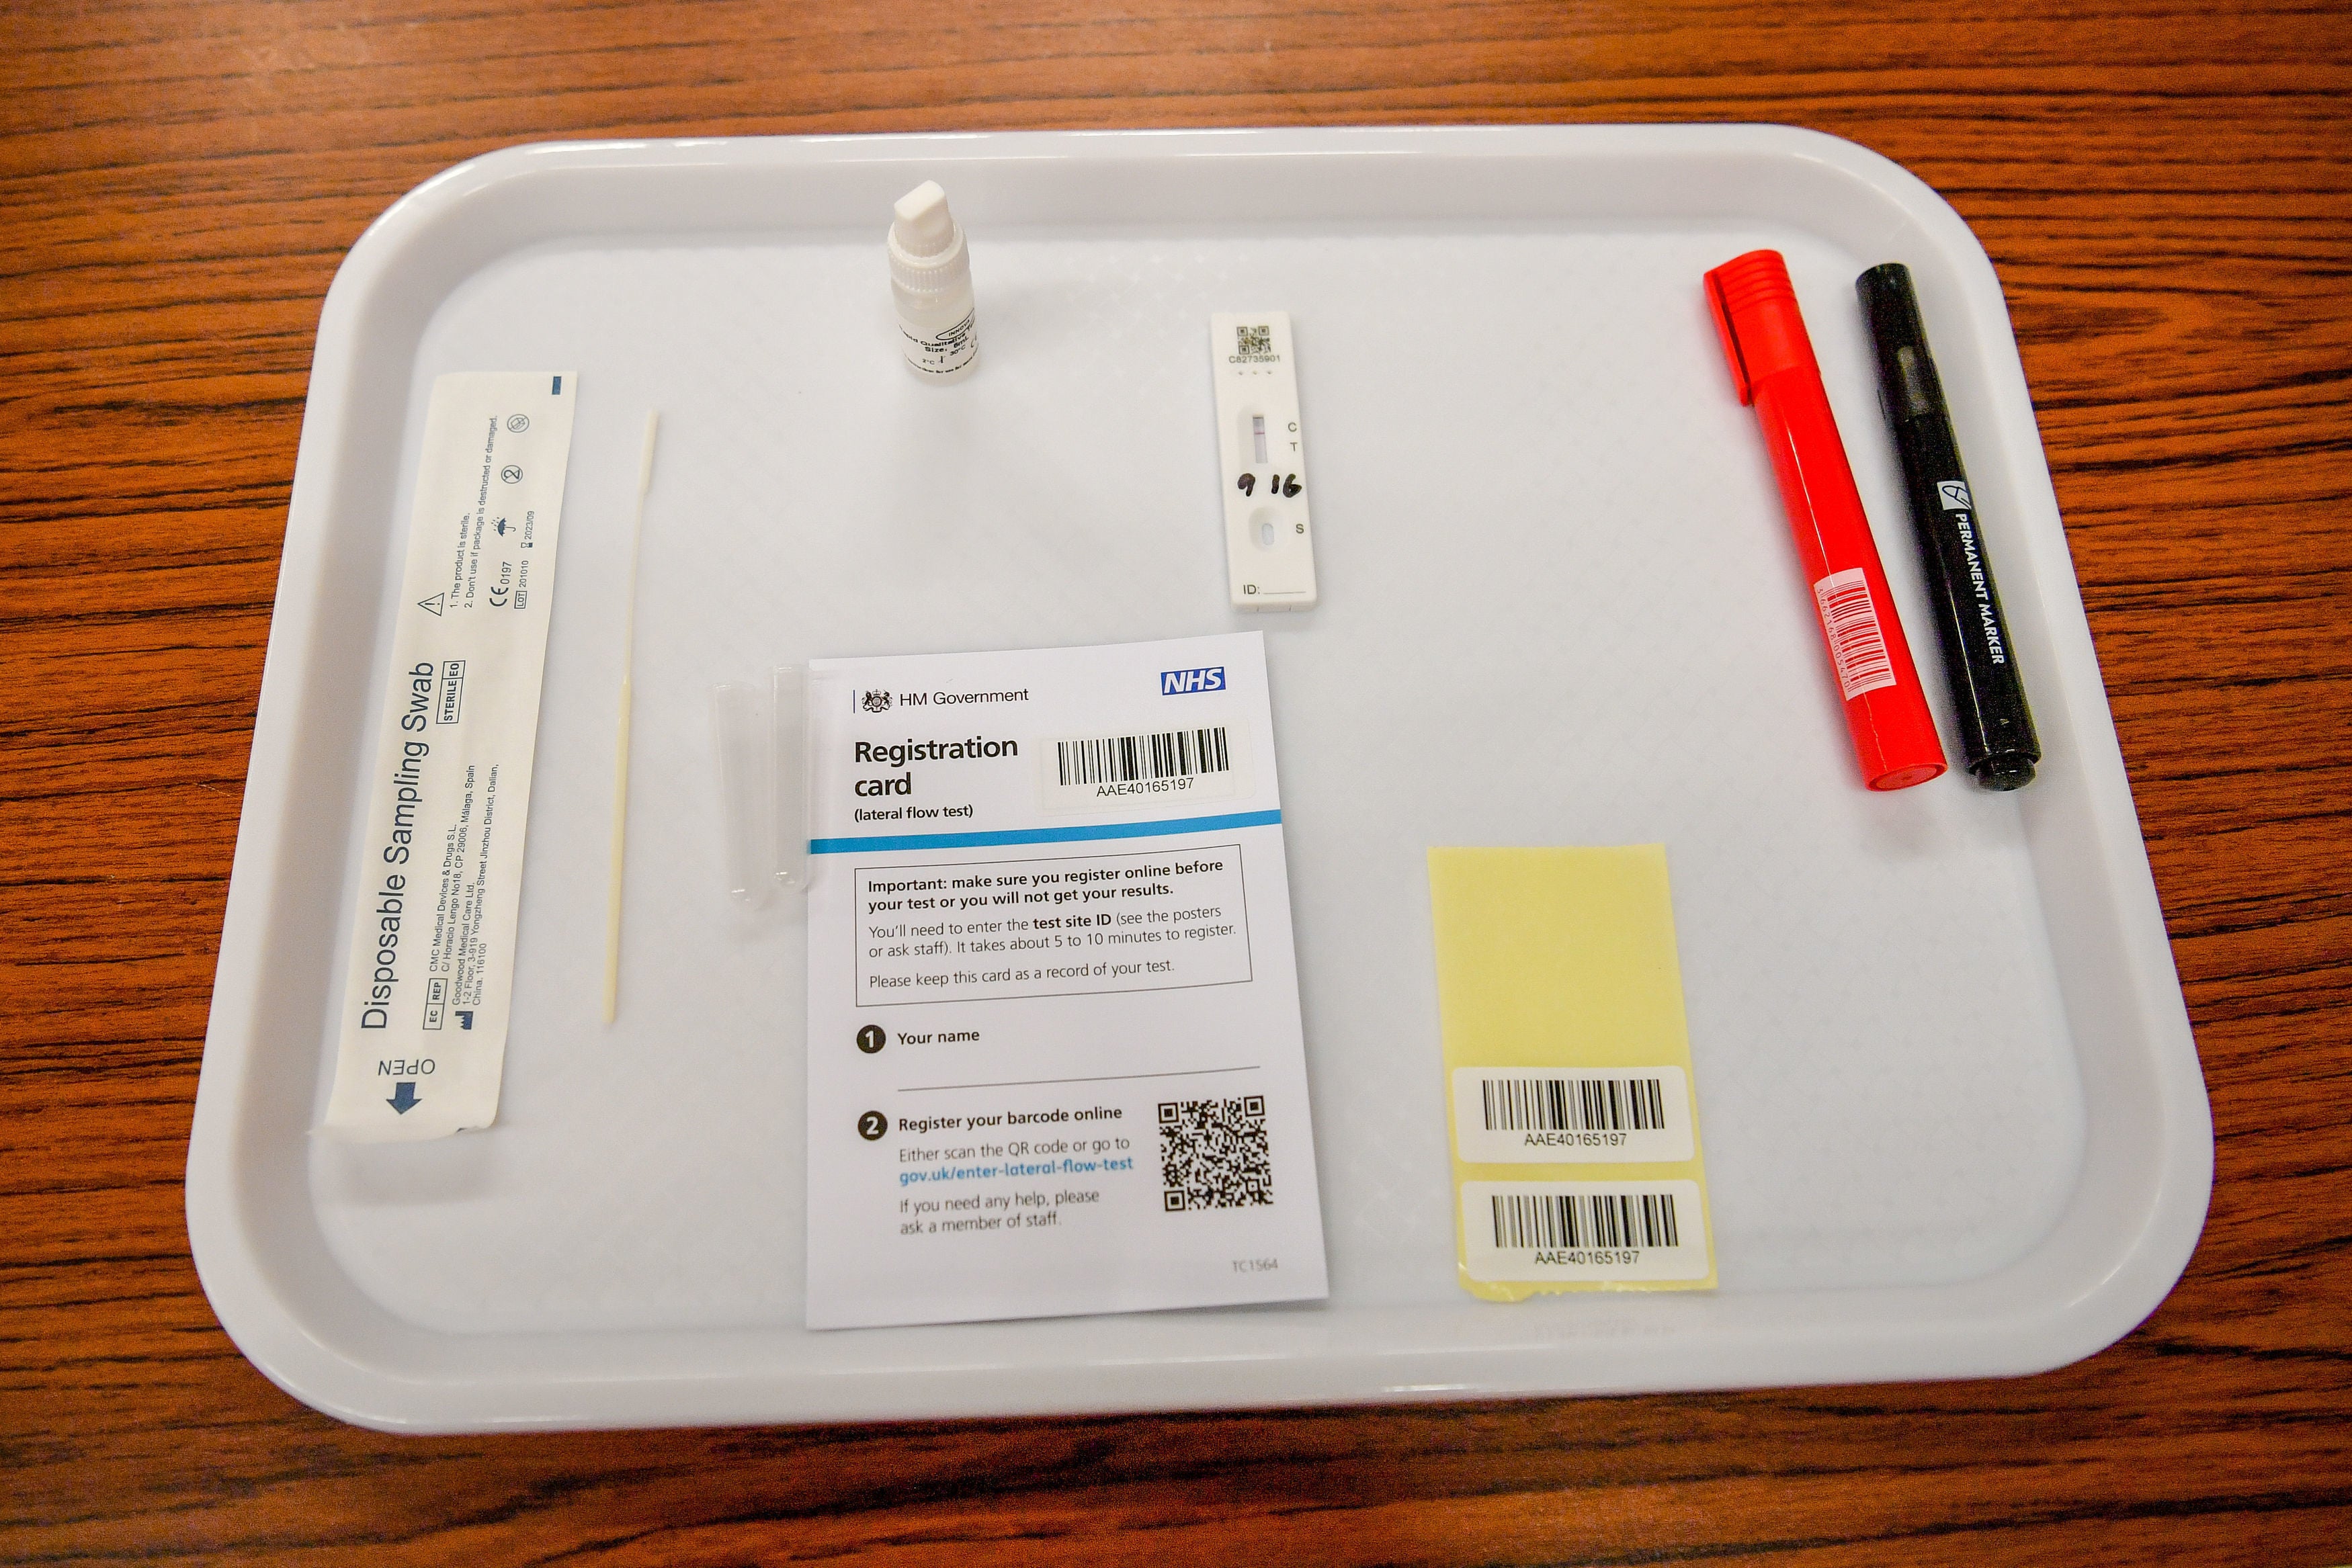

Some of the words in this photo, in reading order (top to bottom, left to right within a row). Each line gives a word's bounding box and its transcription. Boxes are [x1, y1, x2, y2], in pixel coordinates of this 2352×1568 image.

[1228, 353, 1279, 363] C82735901
[485, 416, 497, 453] damaged.
[1288, 422, 1297, 433] C
[485, 454, 492, 463] or
[1290, 442, 1298, 451] T
[478, 465, 491, 506] destructed
[1237, 473, 1256, 497] 9
[1271, 473, 1302, 498] 16
[460, 513, 470, 539] sterile.
[473, 517, 485, 550] package
[524, 511, 535, 540] 2023/09
[1296, 523, 1304, 534] S
[454, 549, 465, 580] product
[470, 559, 478, 574] use
[500, 561, 512, 584] 0197
[518, 560, 529, 588] 201010
[450, 582, 461, 599] The
[517, 593, 525, 607] LOT
[1243, 584, 1260, 595] ID:
[1956, 513, 1988, 600] PERMANENT
[1978, 603, 2005, 664] MARKER
[448, 663, 460, 677] EO
[1164, 668, 1222, 693] NHS
[401, 662, 434, 732] Swab
[444, 680, 458, 722] STERILE
[900, 692, 927, 706] HM
[933, 688, 1030, 705] Government
[855, 736, 1018, 768] Registration
[464, 765, 476, 789] Spain
[855, 771, 912, 799] card
[1096, 777, 1194, 797] AAE40165197
[383, 741, 429, 865] Sampling
[460, 791, 474, 823] Málaga,
[483, 795, 496, 825] District,
[854, 806, 902, 823] (lateral
[905, 806, 939, 819] flow
[942, 803, 973, 818] test)
[447, 824, 457, 840] S.L.
[455, 825, 469, 853] 29006,
[479, 827, 491, 859] Jinzhou
[443, 842, 456, 867] Drugs
[454, 853, 464, 869] CP
[476, 861, 487, 886] Street
[868, 878, 947, 896] Important:
[952, 875, 992, 889] make
[997, 875, 1027, 888] sure
[1032, 874, 1060, 887] you
[1064, 869, 1121, 885] register
[1125, 865, 1171, 879] online
[1175, 860, 1223, 875] before
[437, 878, 450, 911] Devices
[464, 882, 476, 898] Ltd.
[868, 900, 903, 915] your
[907, 897, 936, 910] test
[939, 898, 956, 908] or
[960, 896, 988, 910] you
[992, 889, 1019, 905] will
[1024, 890, 1050, 904] not
[1054, 889, 1079, 905] get
[1082, 889, 1117, 903] your
[1121, 883, 1173, 898] results.
[447, 898, 460, 924] Lengo
[462, 900, 472, 921] Care
[470, 888, 486, 935] Yongzheng
[911, 922, 944, 937] need
[948, 923, 963, 934] to
[967, 921, 1003, 934] enter
[1006, 918, 1029, 931] the
[1032, 917, 1062, 930] test
[1065, 914, 1092, 928] site
[1096, 914, 1111, 926] ID
[1116, 912, 1142, 927] (see
[1146, 910, 1169, 923] the
[1173, 907, 1222, 924] posters
[432, 914, 445, 947] Medical
[442, 926, 455, 959] Horacio
[458, 923, 470, 956] Medical
[869, 947, 884, 958] or
[888, 943, 910, 957] ask
[914, 941, 952, 956] staff).
[957, 941, 966, 953] It
[969, 939, 1005, 953] takes
[1010, 937, 1050, 950] about
[1054, 934, 1062, 947] 5
[1066, 935, 1081, 947] to
[1087, 932, 1103, 945] 10
[1108, 930, 1162, 945] minutes
[1165, 929, 1180, 941] to
[1185, 924, 1236, 941] register.
[360, 875, 406, 1029] Disposable
[429, 949, 440, 972] CMC
[467, 937, 478, 962] 3-919
[476, 943, 487, 974] 116100
[452, 959, 466, 1006] Goodwood
[464, 965, 476, 989] Floor,
[870, 974, 911, 988] Please
[916, 973, 949, 988] keep
[953, 970, 977, 984] this
[982, 967, 1011, 982] card
[1015, 970, 1030, 980] as
[1034, 969, 1042, 979] a
[1046, 963, 1089, 979] record
[1093, 961, 1107, 976] of
[1111, 963, 1142, 978] your
[1146, 959, 1175, 973] test.
[432, 982, 442, 1000] REP
[462, 991, 472, 1004] 1-2
[429, 1010, 438, 1022] EC
[896, 1032, 933, 1045] Your
[938, 1031, 980, 1043] name
[378, 1059, 435, 1076] OPEN
[899, 1116, 962, 1134] Register
[966, 1115, 1003, 1131] your
[1007, 1108, 1069, 1125] barcode
[1074, 1106, 1122, 1121] online
[900, 1147, 939, 1163] Either
[944, 1148, 975, 1160] scan
[980, 1143, 1003, 1158] the
[1008, 1141, 1030, 1157] QR
[1034, 1139, 1068, 1154] code
[1073, 1141, 1087, 1152] or
[1092, 1140, 1111, 1155] go
[1115, 1137, 1130, 1149] to
[1524, 1133, 1627, 1146] AAE40165197
[899, 1156, 1134, 1187] gov.uk/enter-lateral-flow-test
[900, 1199, 909, 1213] If
[914, 1201, 939, 1217] you
[945, 1194, 980, 1211] need
[985, 1196, 1011, 1211] any
[1015, 1191, 1050, 1209] help,
[1055, 1190, 1099, 1207] please
[900, 1219, 923, 1235] ask
[929, 1222, 937, 1233] a
[942, 1216, 1002, 1231] member
[1007, 1213, 1021, 1228] of
[1025, 1209, 1062, 1227] staff.
[1232, 1258, 1278, 1272] TC1564
[1534, 1250, 1640, 1265] AAE40165197
